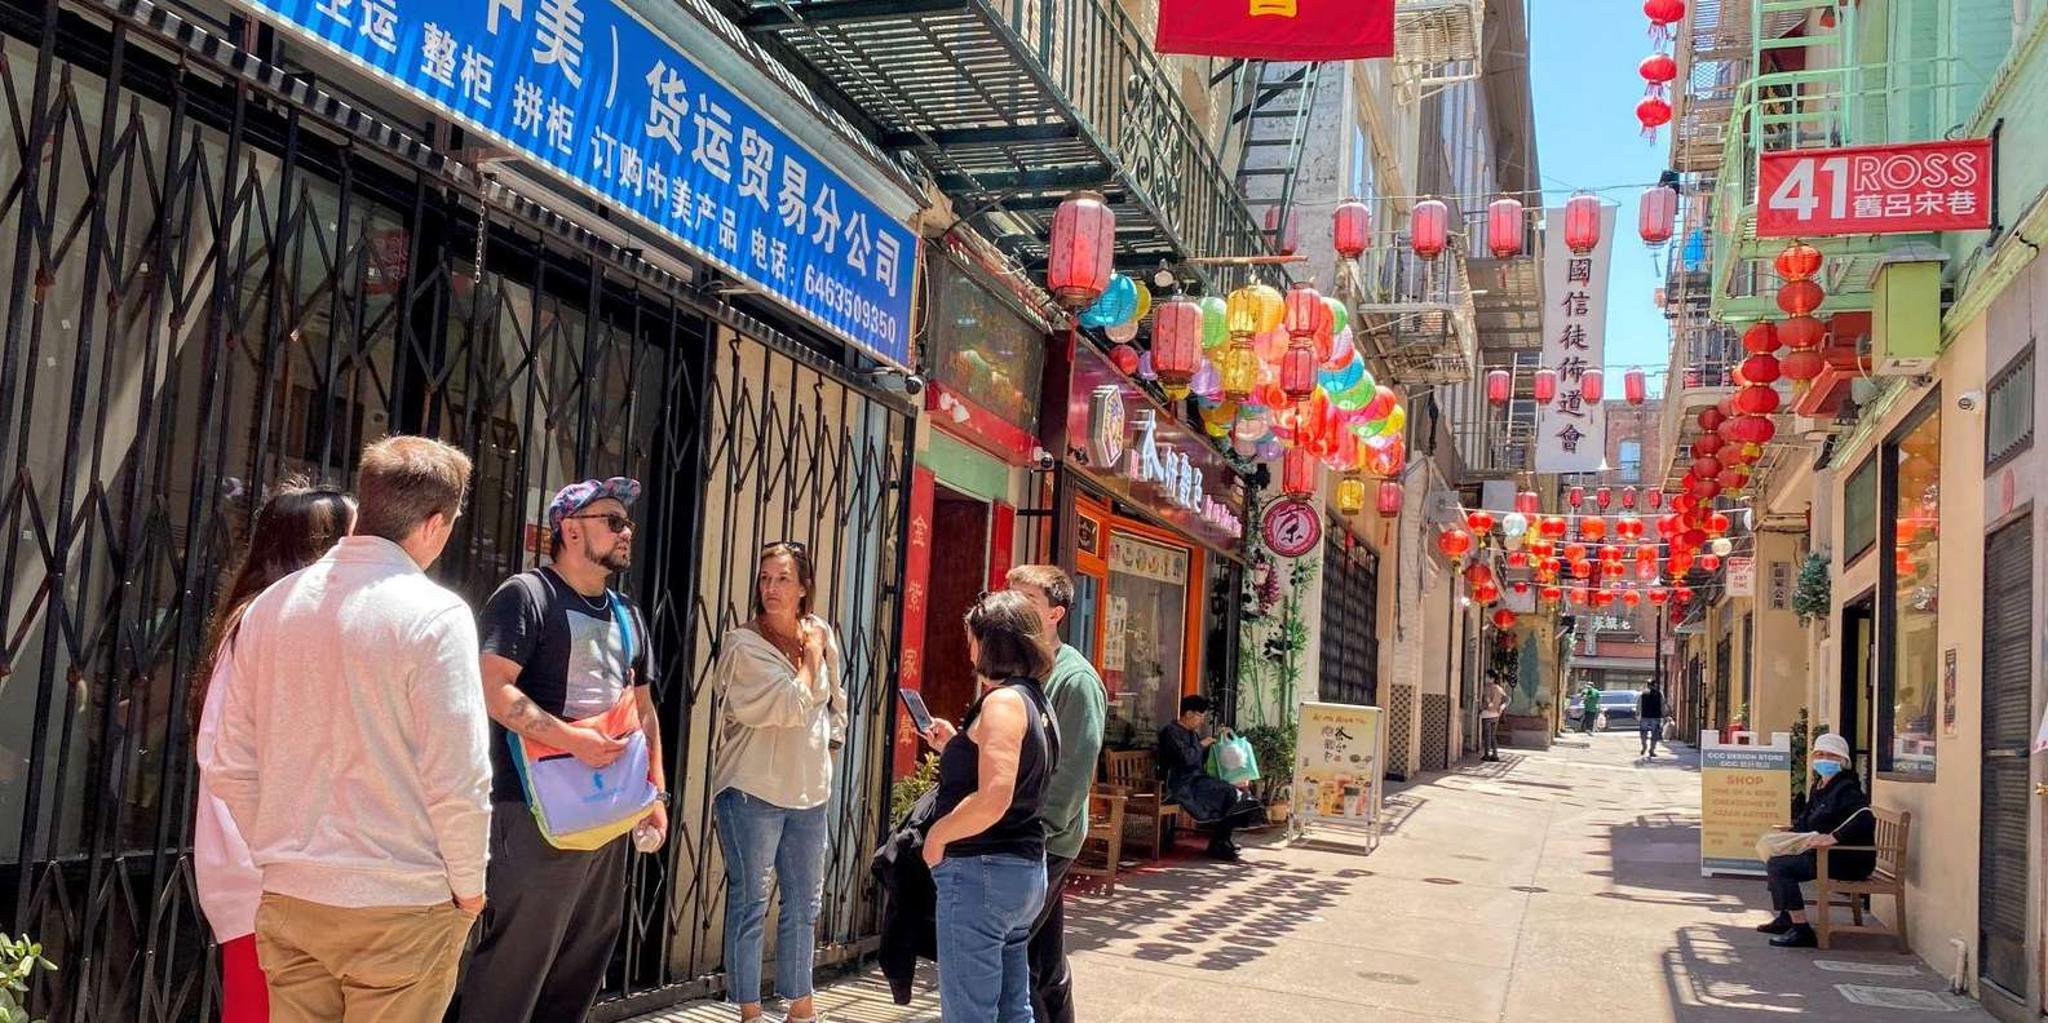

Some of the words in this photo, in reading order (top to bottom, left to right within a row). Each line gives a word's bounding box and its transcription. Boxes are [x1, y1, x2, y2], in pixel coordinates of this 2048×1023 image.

[420, 22, 495, 109] 整柜
[513, 76, 575, 155] 拼柜
[591, 124, 738, 254] 订购中美产品
[804, 263, 897, 345] 6463509350
[1769, 157, 1849, 221] 41
[1854, 152, 1978, 192] ROSS
[1852, 190, 1977, 219] 舊呂宋巷
[1707, 752, 1726, 760] CCC
[1758, 754, 1784, 762] STORE
[1726, 774, 1764, 785] SHOP
